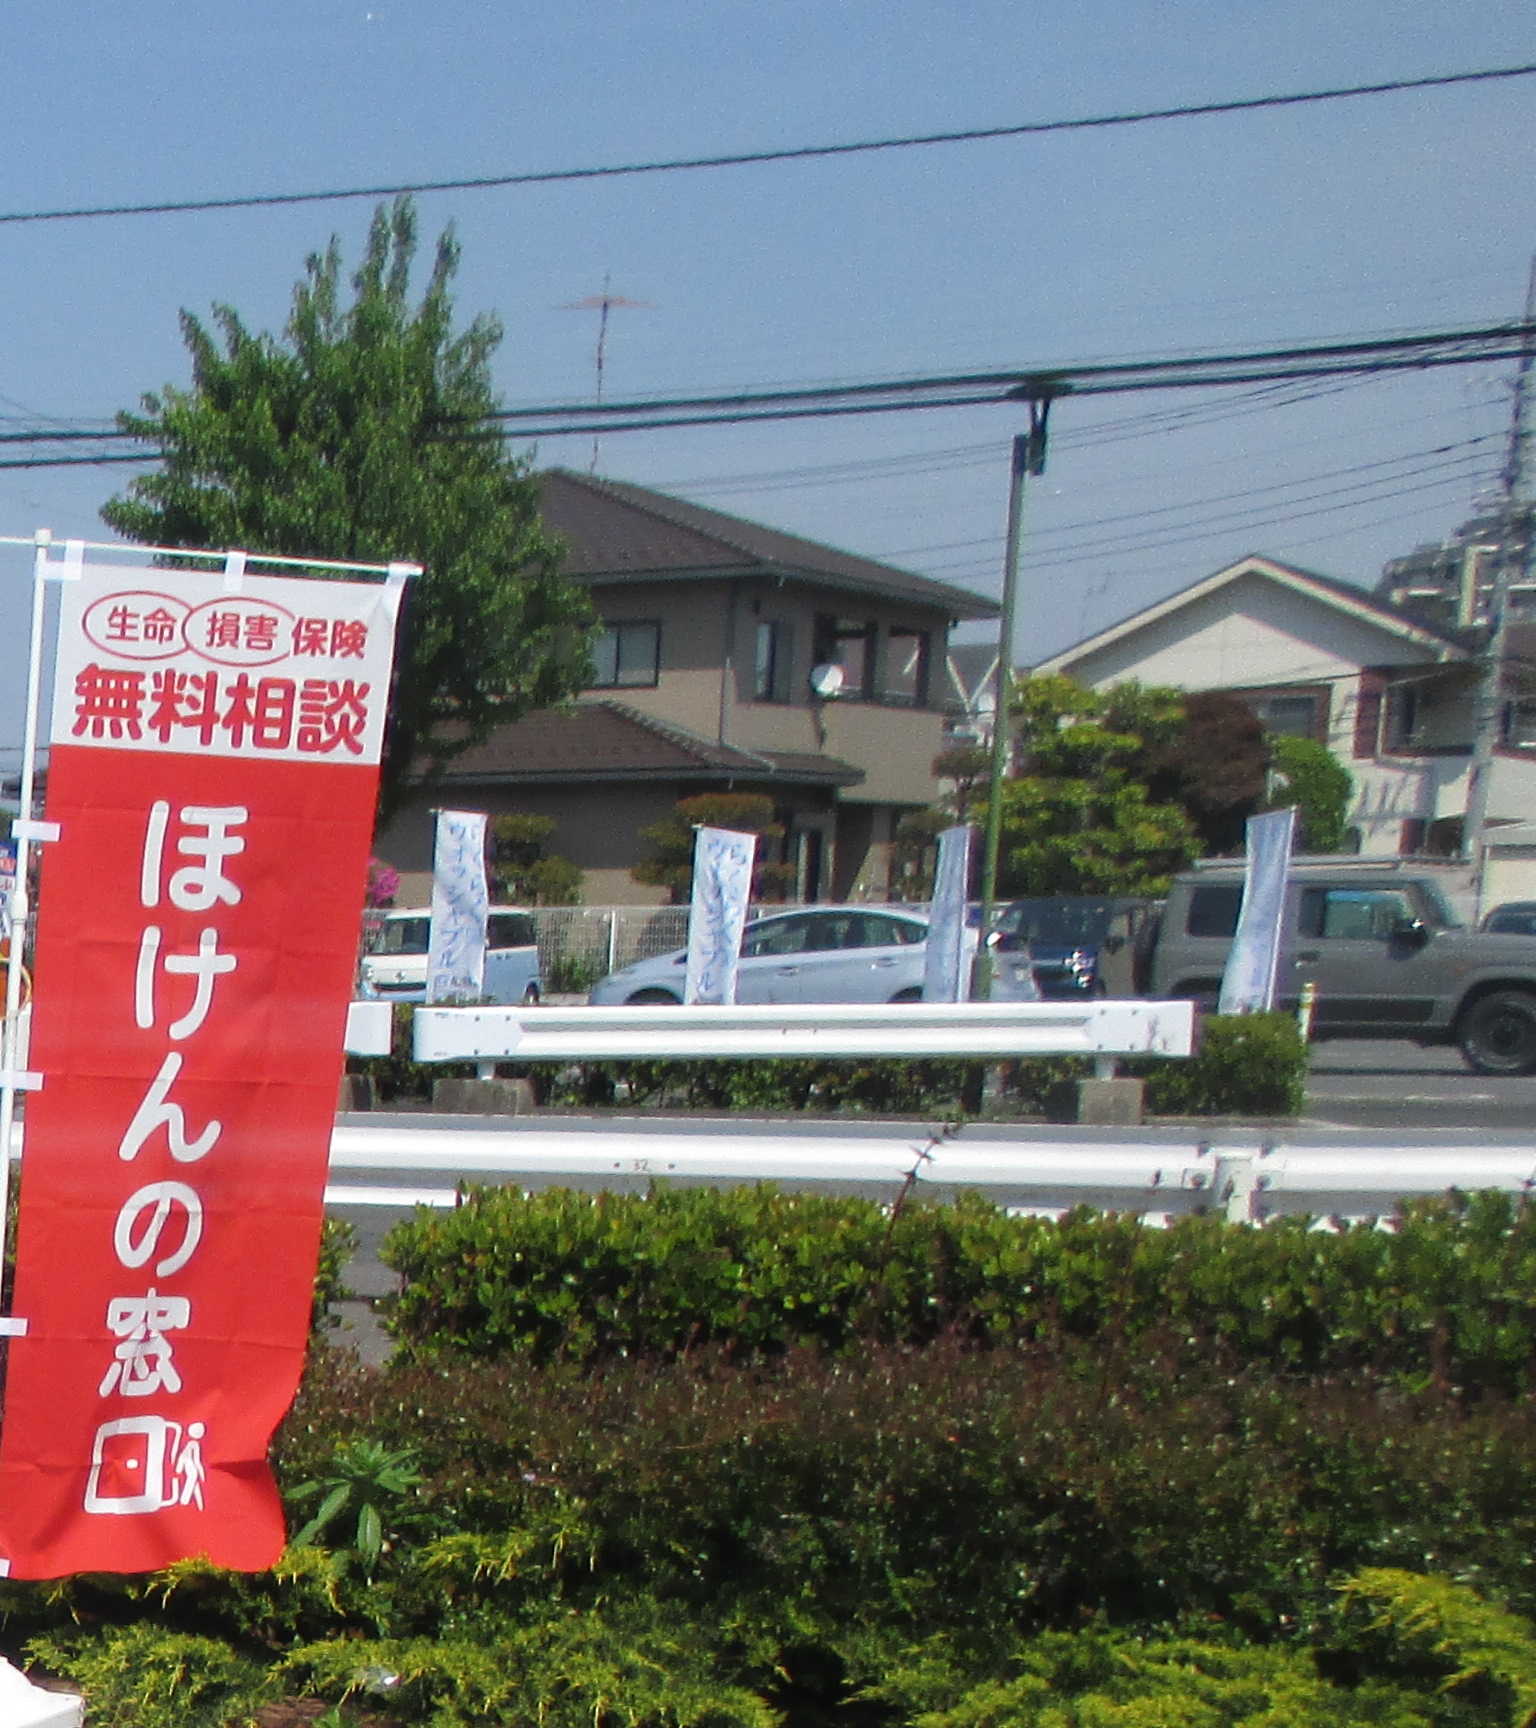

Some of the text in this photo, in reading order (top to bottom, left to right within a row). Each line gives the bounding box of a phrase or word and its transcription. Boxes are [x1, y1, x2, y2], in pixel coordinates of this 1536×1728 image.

[107, 606, 368, 659] 生命 損害 保険
[71, 662, 372, 756] 無料相談
[83, 799, 250, 1515] ほけんの窓口
